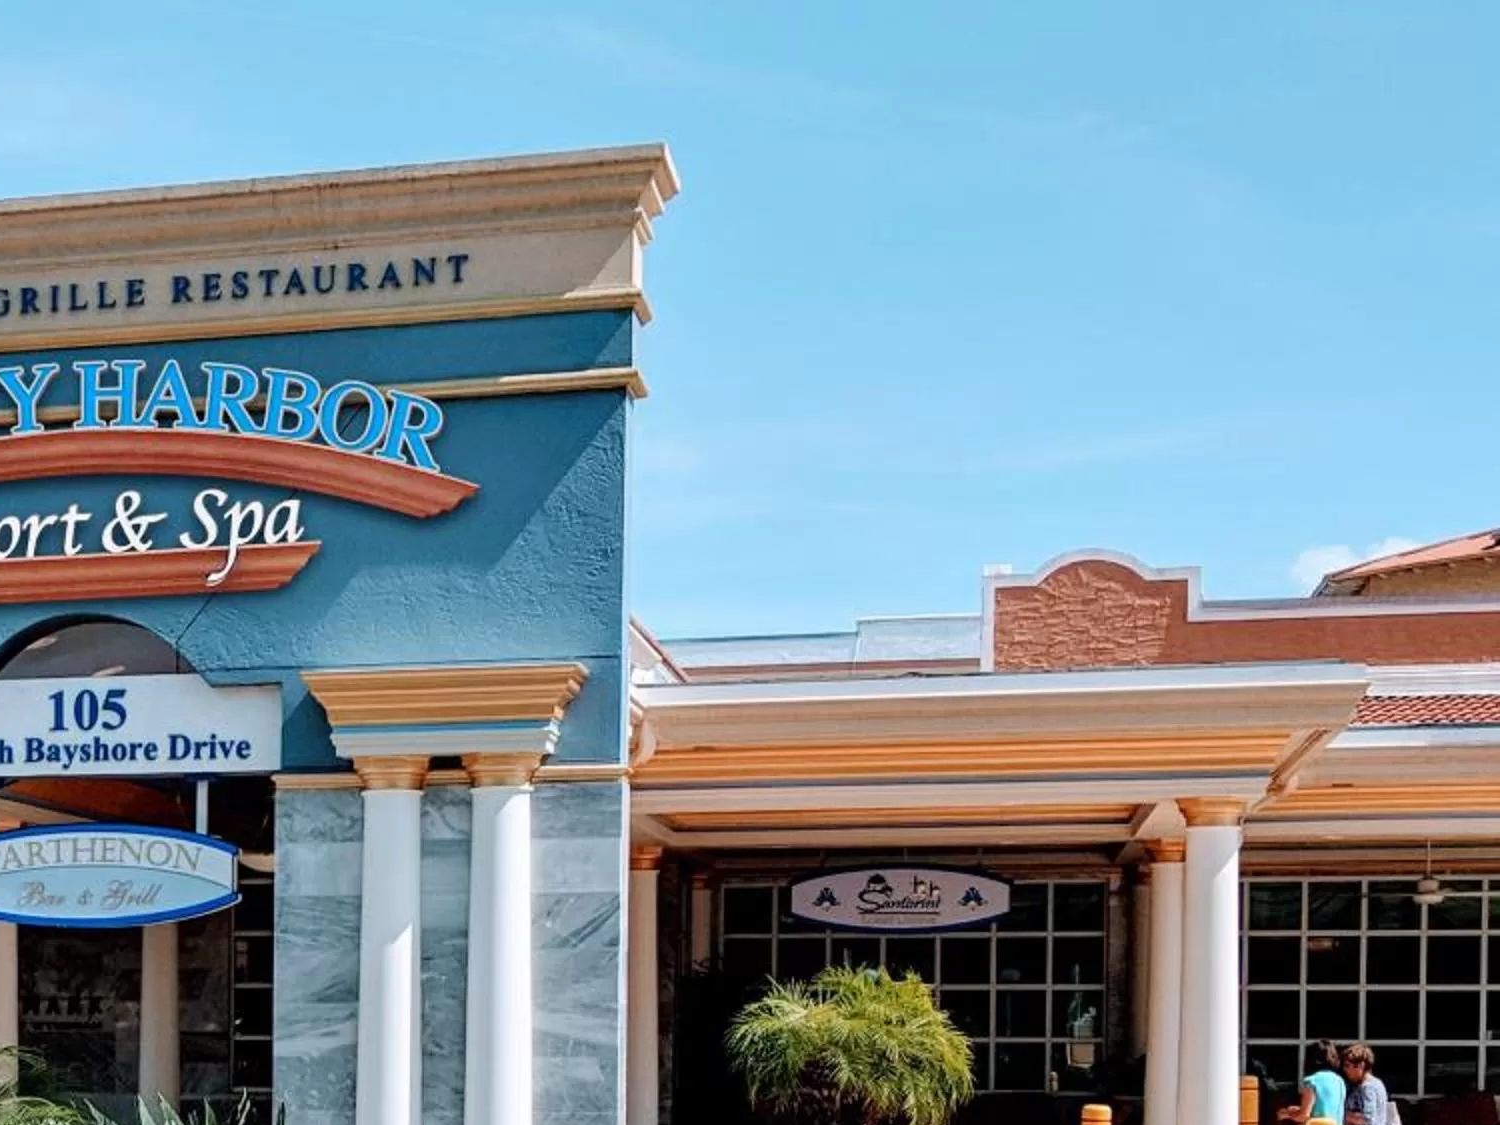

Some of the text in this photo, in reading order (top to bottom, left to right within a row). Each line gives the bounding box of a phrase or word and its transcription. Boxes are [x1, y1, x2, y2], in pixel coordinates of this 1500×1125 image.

[171, 253, 471, 305] RESTAURANT
[73, 358, 445, 474] HARBOR
[101, 490, 167, 554] &
[180, 488, 305, 588] Spa
[48, 688, 128, 732] 105
[24, 735, 158, 770] Bayshore
[168, 733, 252, 761] Drive
[17, 880, 67, 908] Bar
[100, 879, 164, 912] Grill
